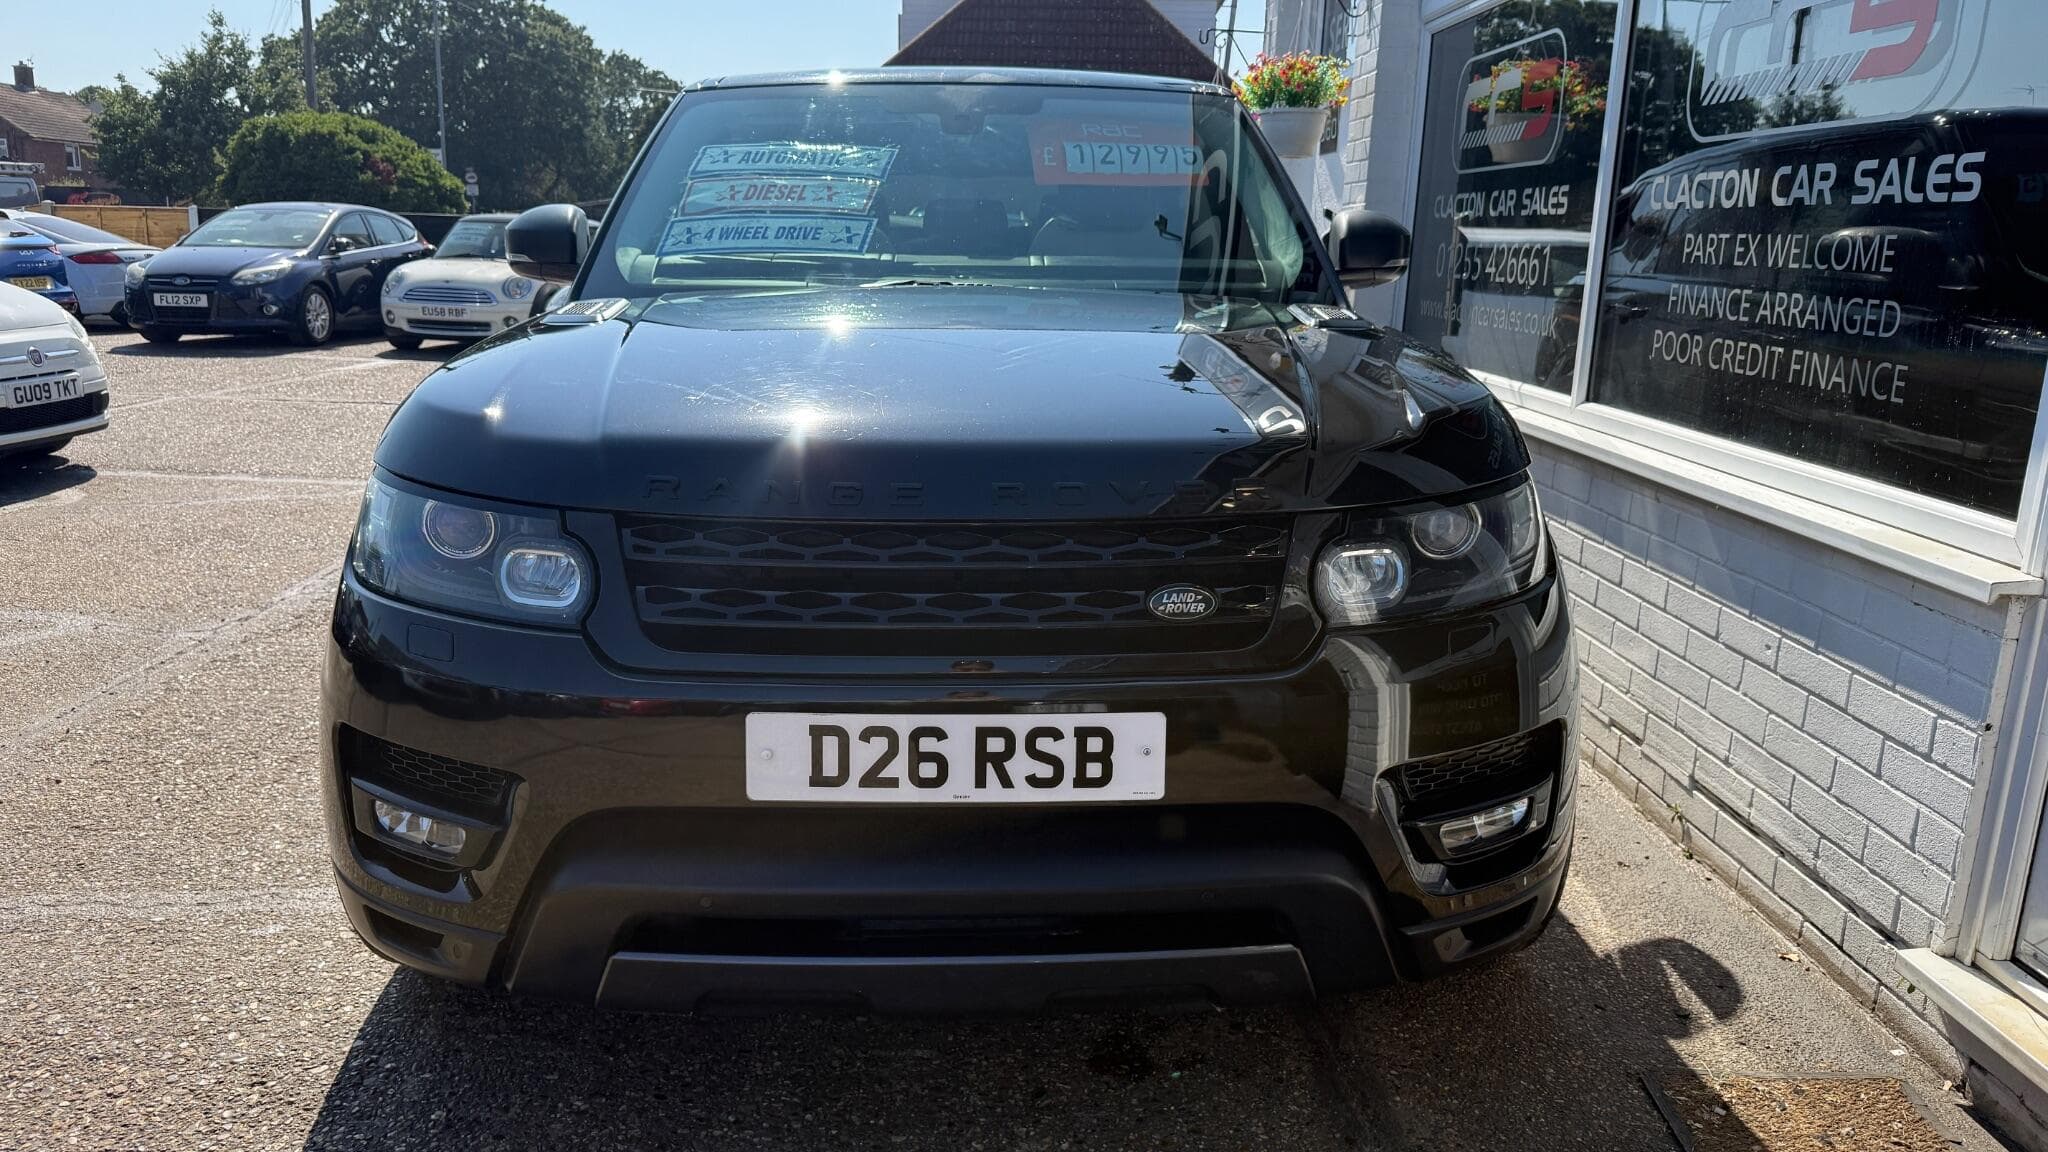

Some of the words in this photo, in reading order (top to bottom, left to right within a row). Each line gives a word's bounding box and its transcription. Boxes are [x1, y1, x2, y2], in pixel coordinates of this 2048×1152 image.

[737, 150, 847, 167] AUTOMATIC
[743, 184, 807, 201] DIESEL
[1650, 167, 1760, 210] CLACTON
[1771, 162, 1837, 207] CAR
[1851, 151, 1986, 204] SALES
[1434, 191, 1486, 220] CLACTON
[1489, 188, 1517, 217] CAR
[1520, 184, 1570, 216] SALES
[704, 226, 713, 241] 4
[718, 226, 769, 241] WHEEL
[774, 226, 824, 241] DRIVE
[1485, 243, 1551, 287] 426661
[1682, 233, 1730, 265] PART
[1733, 234, 1763, 267] EX
[1767, 234, 1898, 273] WELCOME
[160, 295, 180, 305] FL12
[182, 295, 201, 305] SXP
[1667, 283, 1753, 322] FINANCE
[1755, 291, 1901, 338] ARRANGED
[1651, 329, 1703, 367] POOR
[1708, 338, 1785, 381] CREDIT
[1788, 349, 1909, 404] FINANCE
[13, 382, 52, 405] GU09
[54, 378, 78, 398] TKT
[643, 474, 925, 507] RANGE
[990, 477, 1273, 508] ROVER
[1162, 592, 1196, 603] LAND
[1165, 602, 1206, 613] ROVER
[808, 724, 949, 789] D26
[974, 725, 1115, 789] RSB
